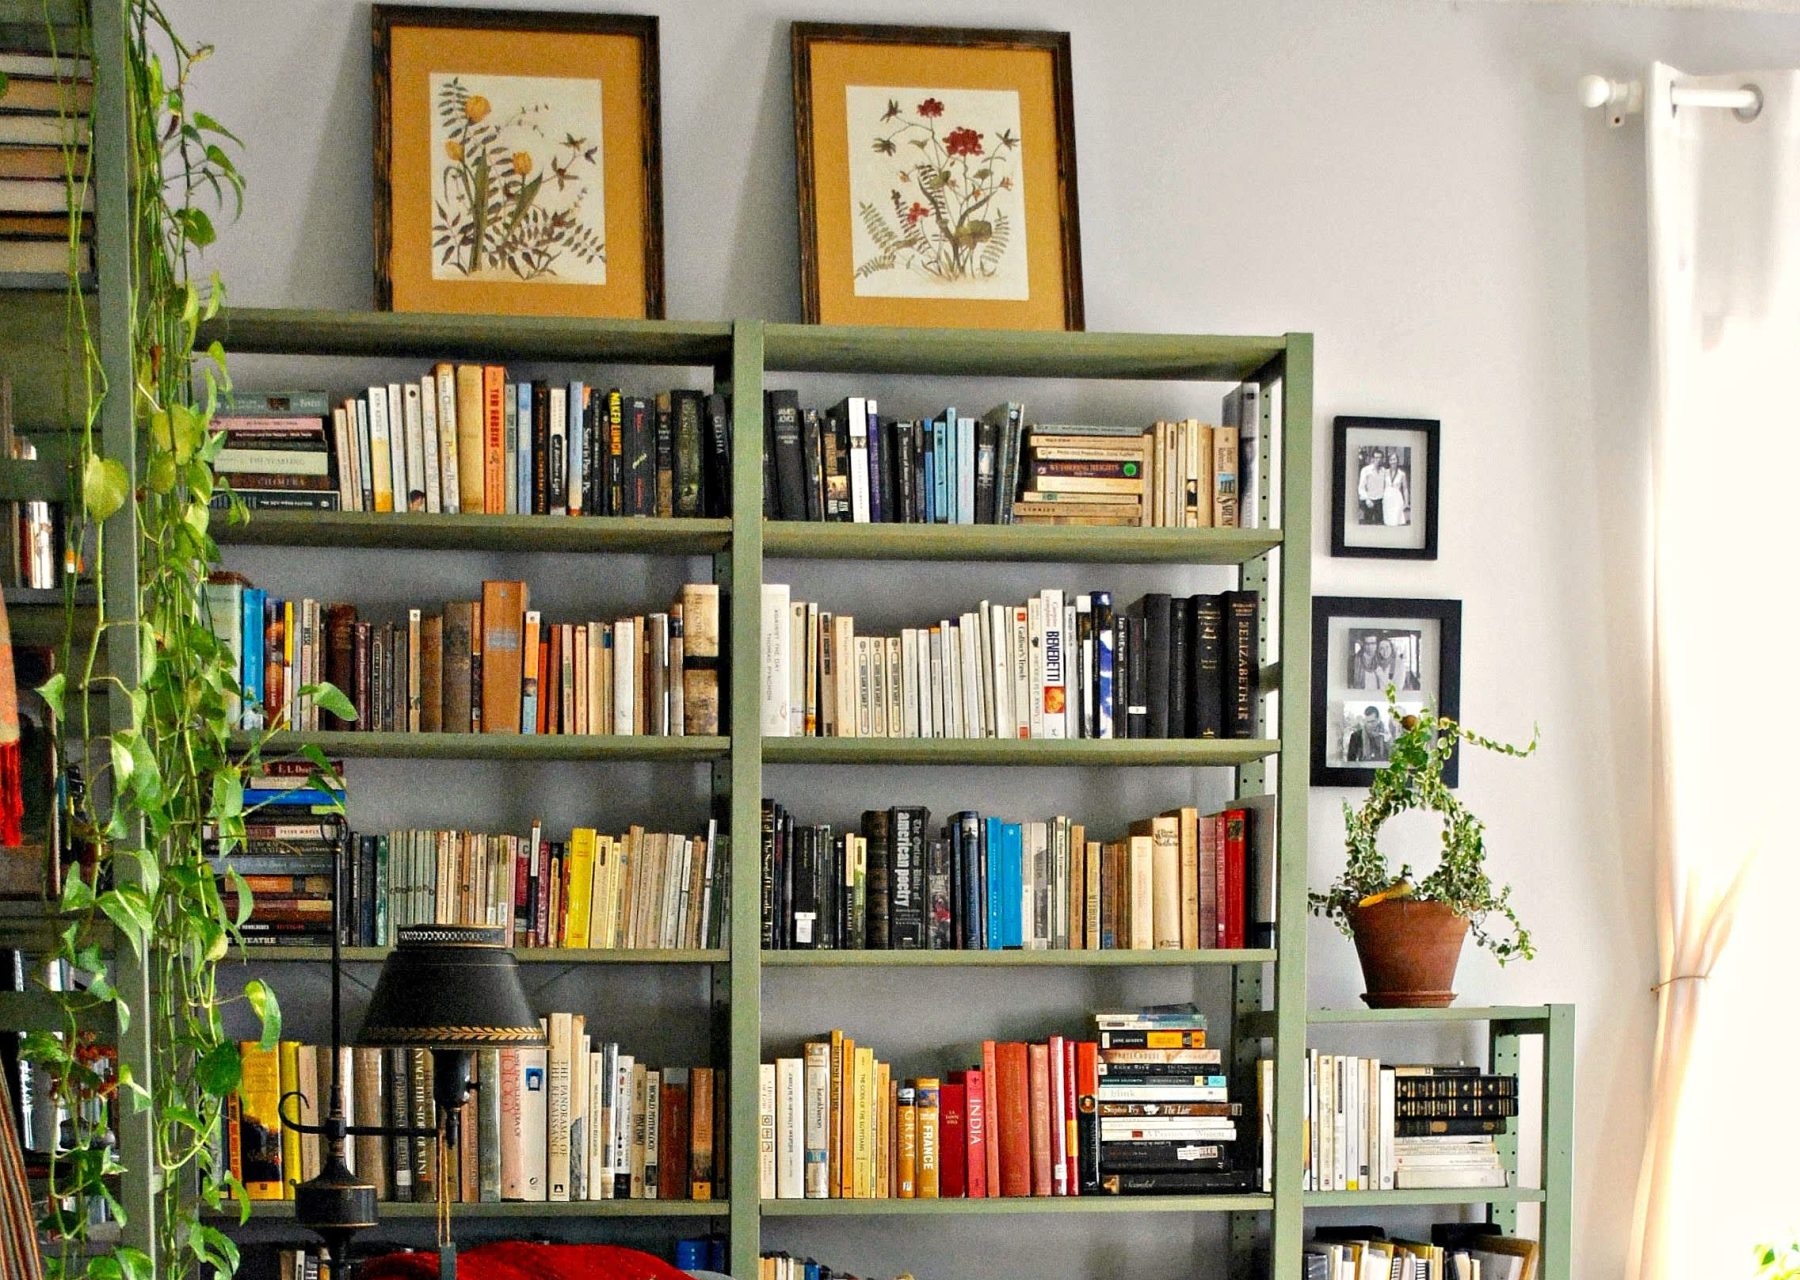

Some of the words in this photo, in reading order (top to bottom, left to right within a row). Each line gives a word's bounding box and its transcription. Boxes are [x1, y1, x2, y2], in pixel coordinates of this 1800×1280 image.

[490, 388, 500, 407] TOM
[610, 391, 622, 424] NAKED
[490, 409, 500, 448] ROBBINS
[583, 428, 591, 450] Satori
[610, 424, 622, 456] LUNCH
[714, 416, 724, 454] GEISHA
[583, 459, 591, 475] Paris
[1118, 617, 1126, 630] Ian
[1046, 631, 1060, 682] BENEDETTI
[1118, 631, 1126, 662] McEwan
[1238, 629, 1249, 702] ELIZABETH
[762, 840, 772, 852] The
[897, 812, 913, 867] american
[895, 868, 911, 907] poetry
[551, 1061, 560, 1080] THE
[560, 1061, 569, 1080] THE
[560, 1085, 569, 1135] PANORAMA
[648, 1085, 658, 1110] WORLD
[832, 1080, 840, 1112] EMPIRE
[1104, 1104, 1127, 1114] Stephen
[1128, 1104, 1141, 1114] Fry
[1162, 1104, 1177, 1114] The
[1178, 1104, 1192, 1114] Liar
[416, 1106, 426, 1129] STOR
[551, 1085, 560, 1157] RENAISSANCE
[648, 1111, 658, 1151] MYTHOLOGY
[970, 1098, 982, 1145] INDIA
[905, 1110, 915, 1158] GREAT
[923, 1125, 934, 1169] FRANCE
[560, 1144, 569, 1157] OF
